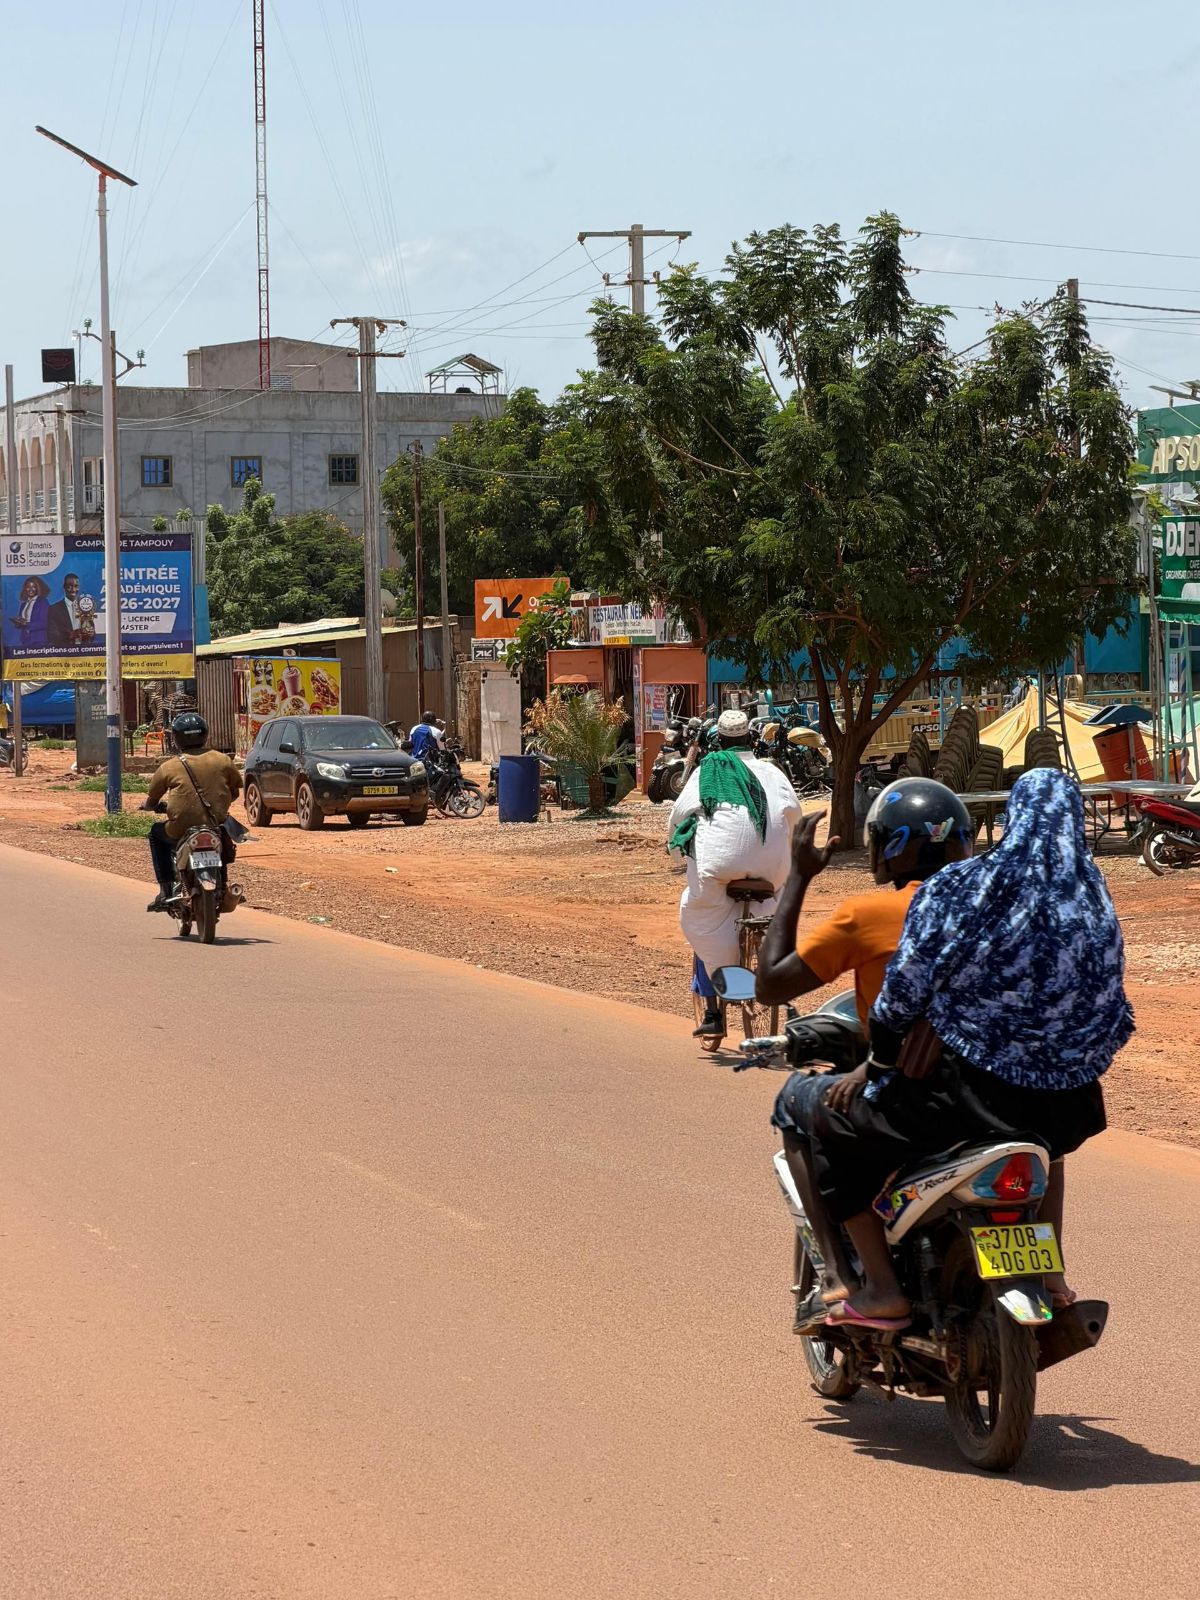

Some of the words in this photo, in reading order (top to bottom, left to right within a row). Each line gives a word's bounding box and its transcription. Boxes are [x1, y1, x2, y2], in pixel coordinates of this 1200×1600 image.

[28, 541, 53, 549] Umanis
[129, 539, 174, 547] TAMPOUY
[6, 554, 26, 564] UBS
[28, 550, 57, 558] Business
[28, 559, 50, 567] School
[100, 597, 181, 610] 226-2027
[593, 605, 629, 622] RESTAURANT
[26, 646, 67, 655] inscriptions
[137, 642, 179, 651] poursuivent
[989, 1226, 1038, 1250] 3708
[978, 1242, 993, 1252] BF
[1028, 1249, 1053, 1271] 03
